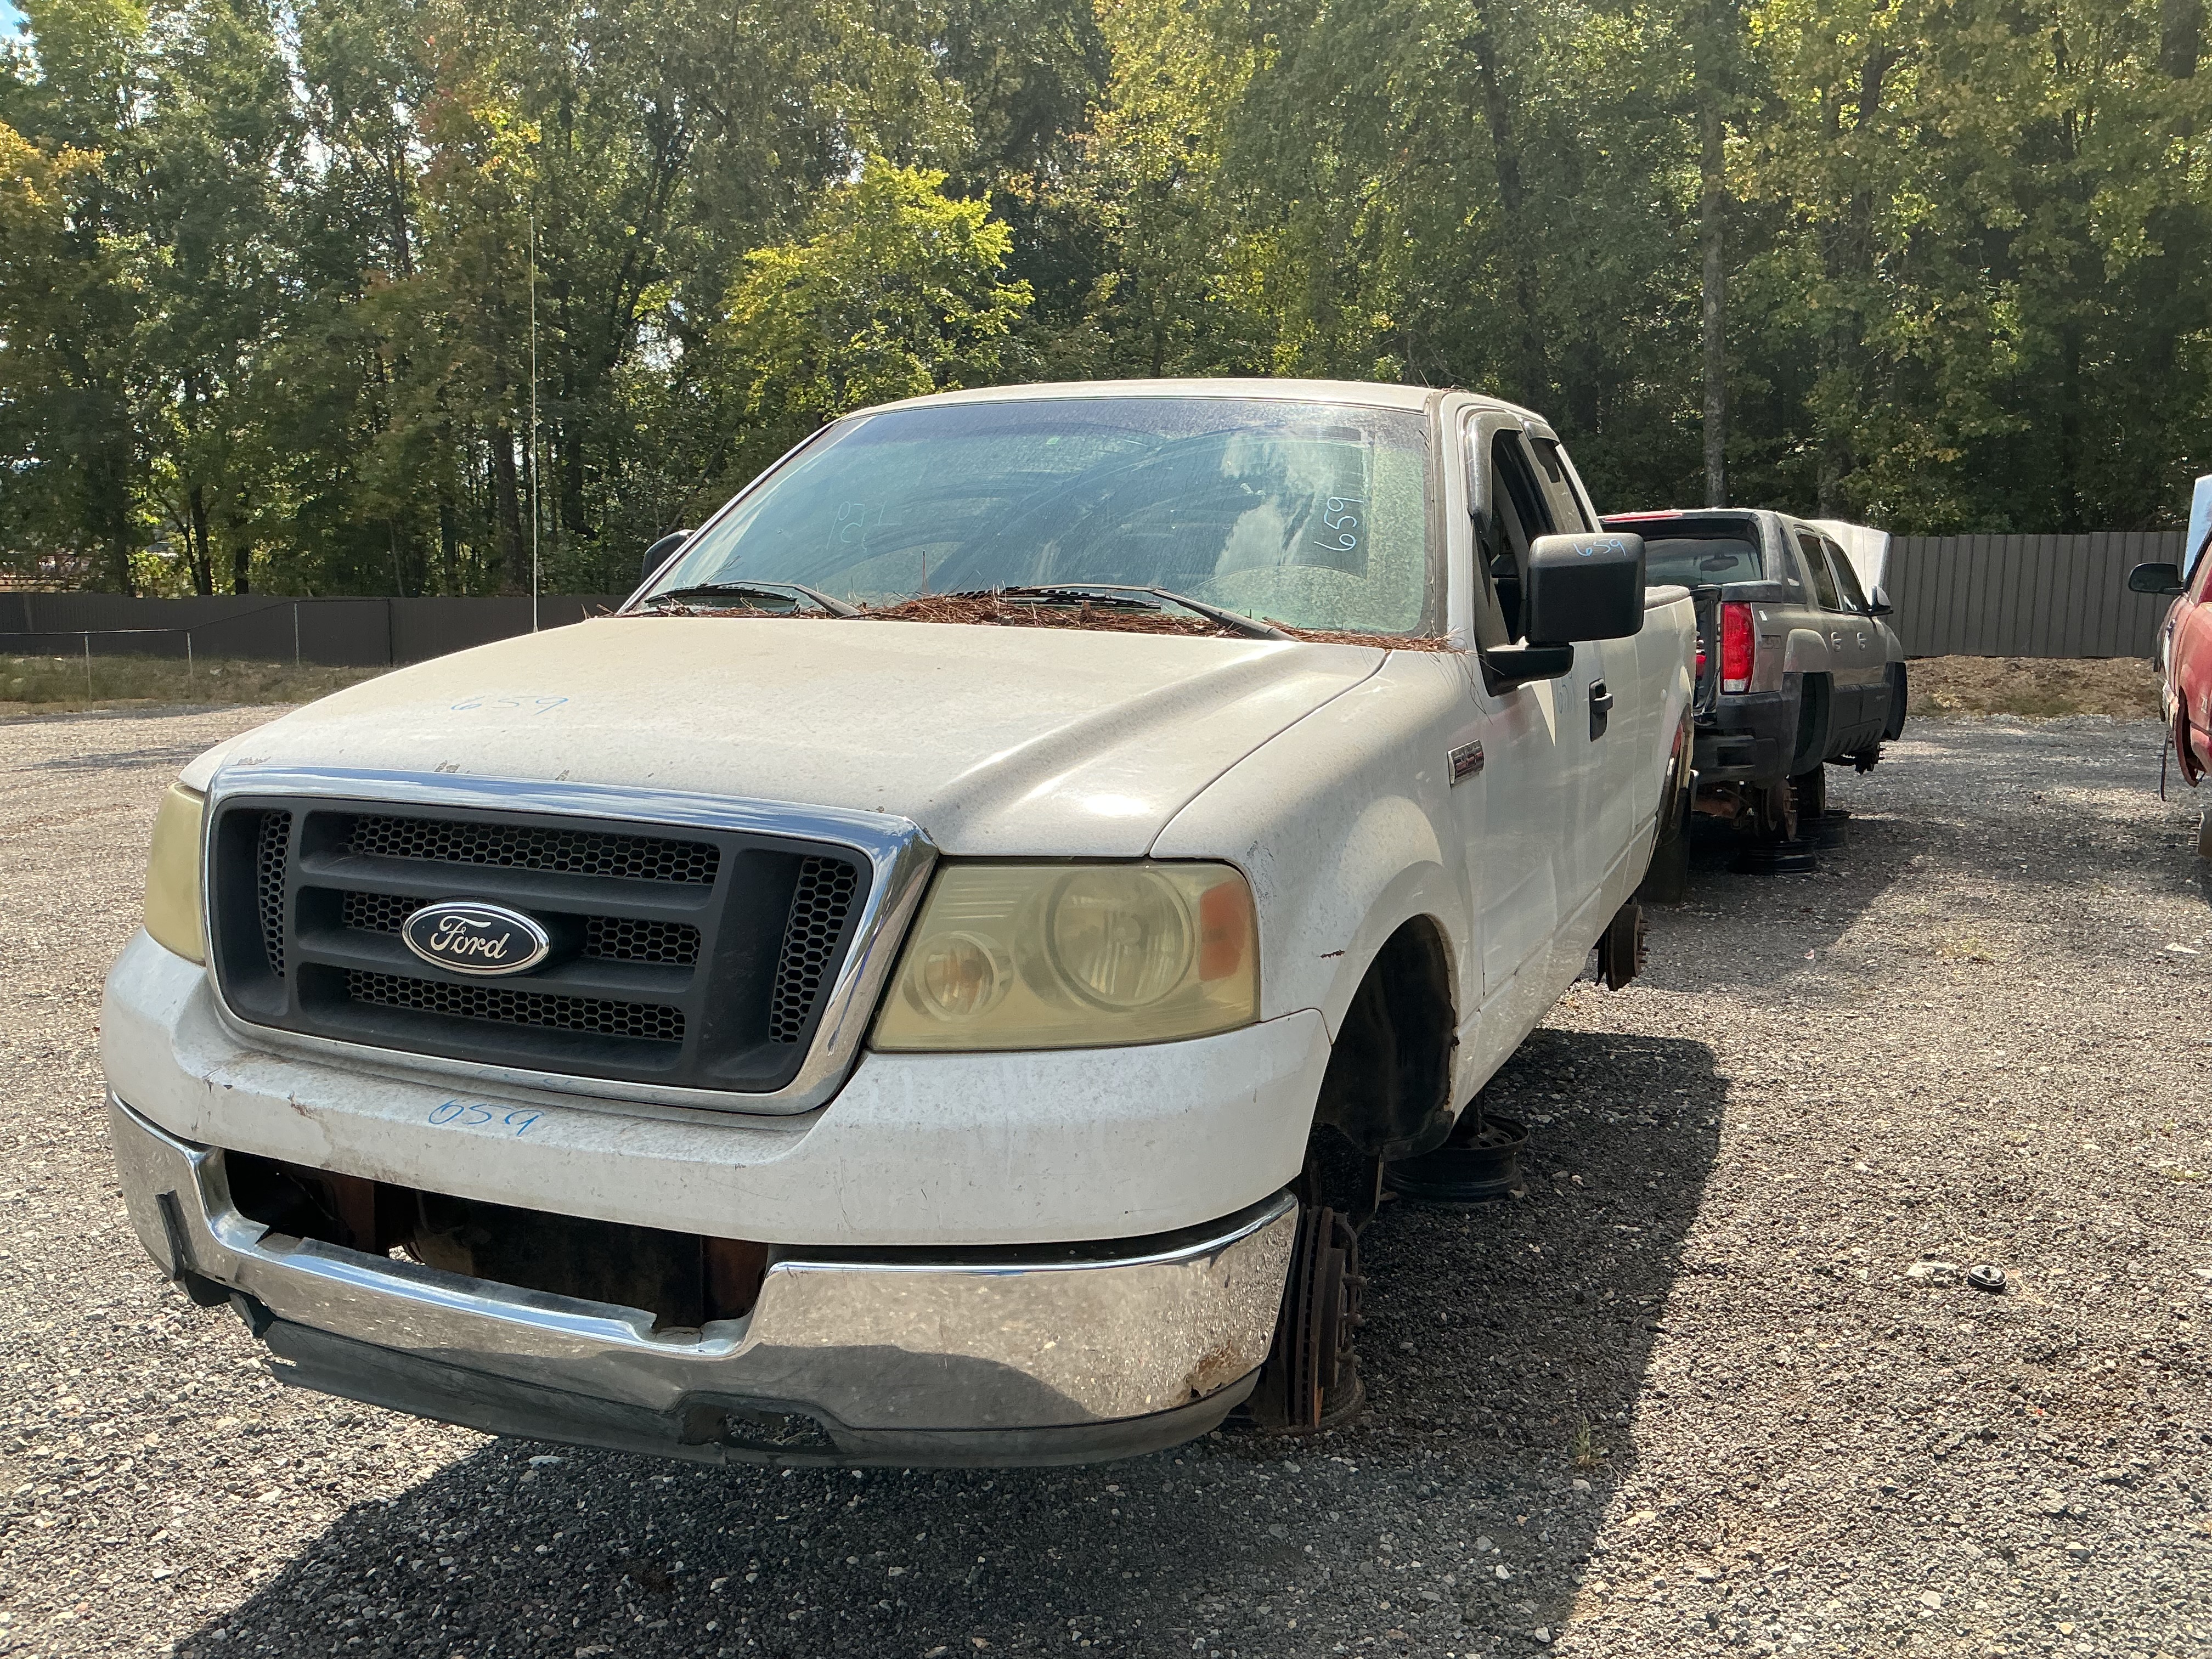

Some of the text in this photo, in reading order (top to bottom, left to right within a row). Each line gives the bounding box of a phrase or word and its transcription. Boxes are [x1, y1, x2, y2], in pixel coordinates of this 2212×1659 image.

[1313, 496, 1364, 551] 659
[1573, 539, 1627, 557] 659
[450, 695, 569, 716] 659
[430, 915, 511, 960] Ford
[428, 1098, 545, 1136] 659
